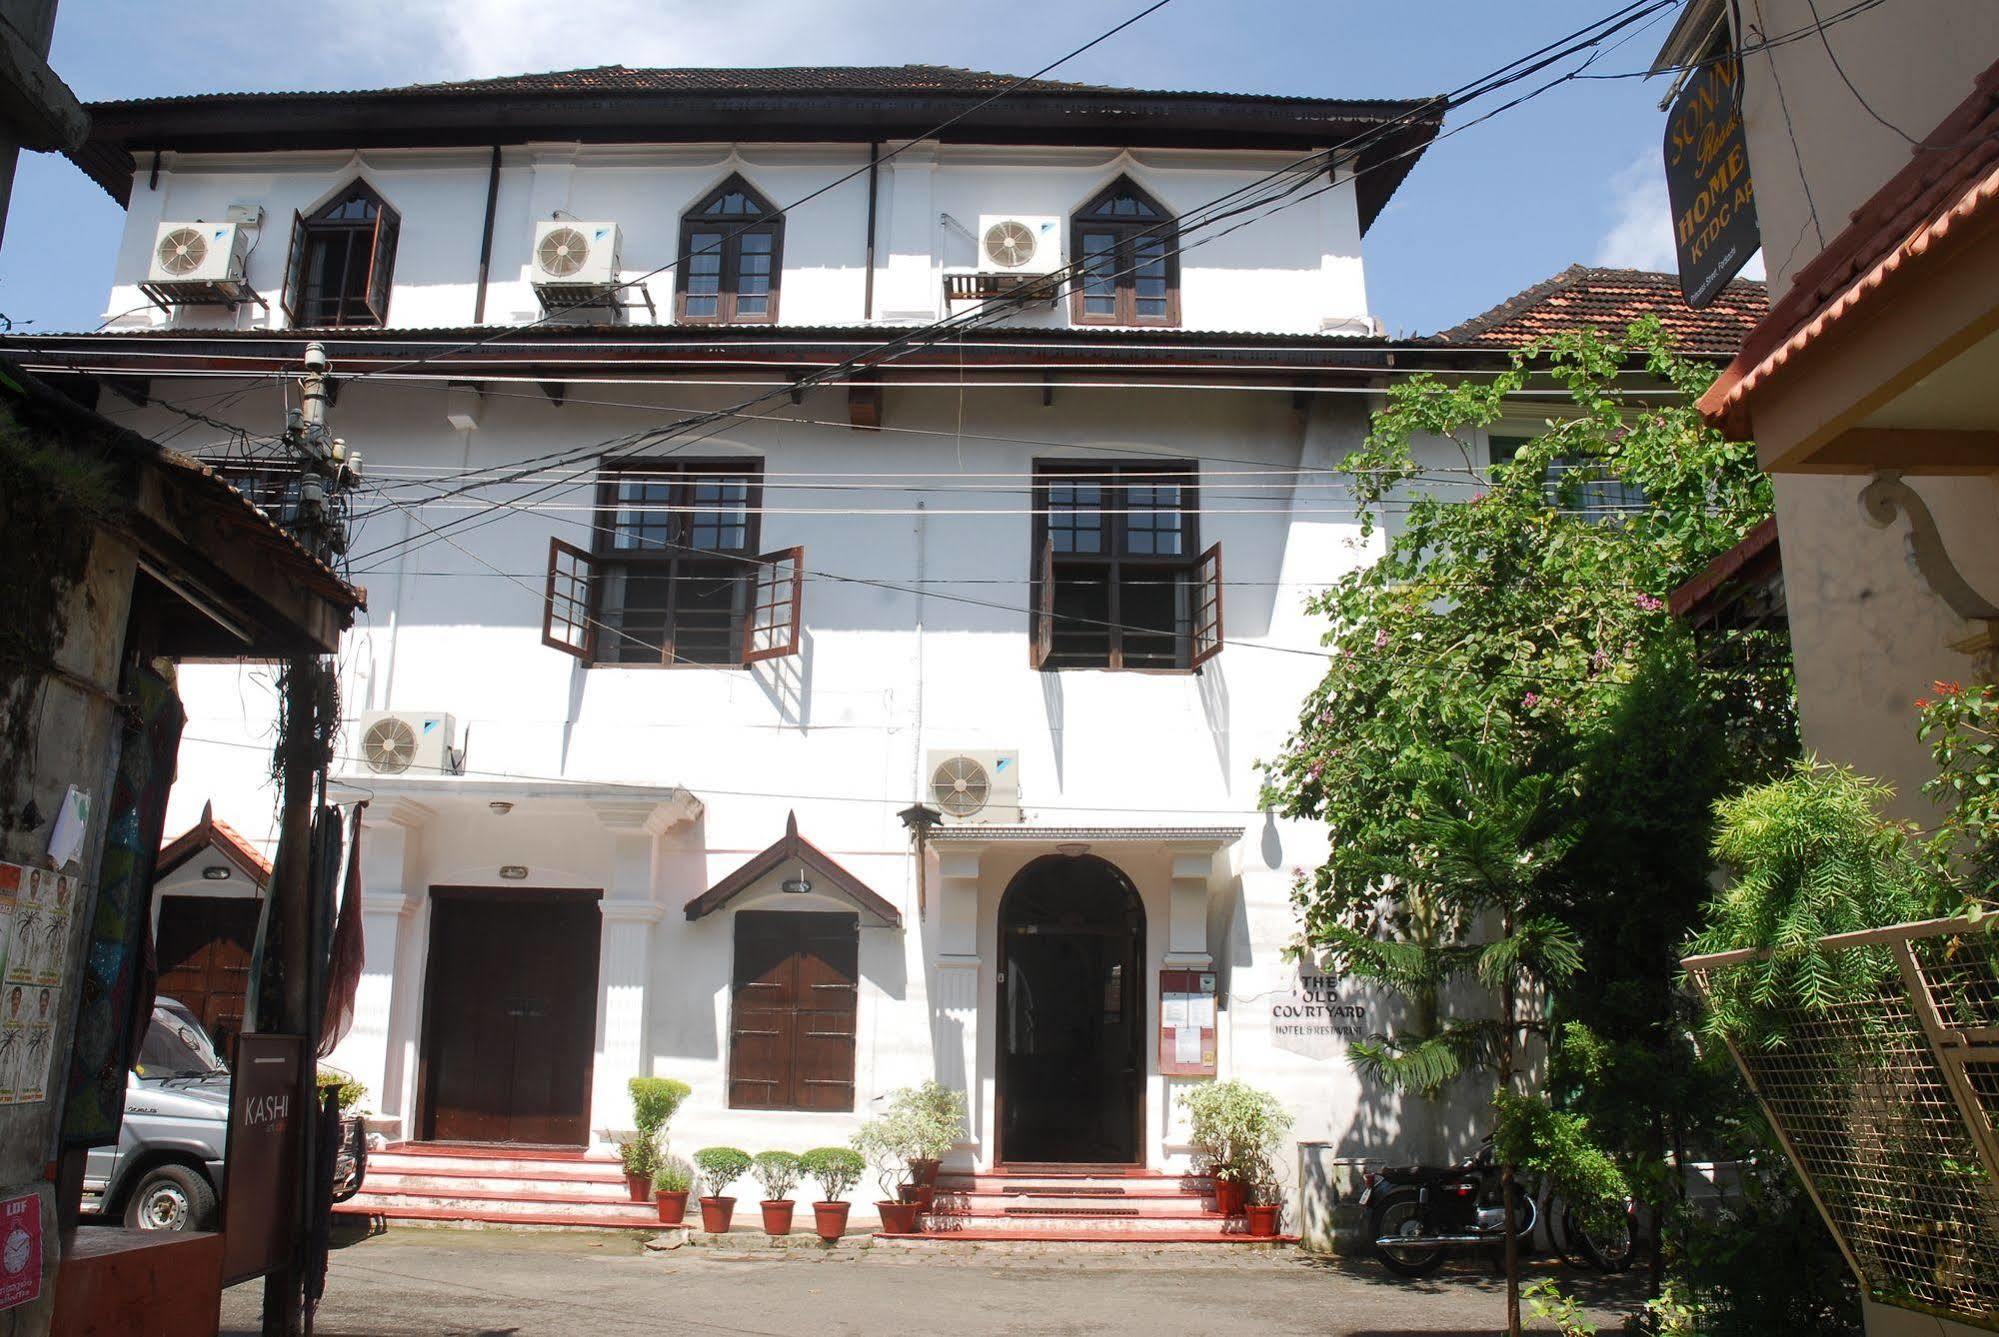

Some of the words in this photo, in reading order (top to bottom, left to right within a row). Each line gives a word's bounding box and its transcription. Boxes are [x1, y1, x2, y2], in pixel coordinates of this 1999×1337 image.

[1678, 143, 1745, 247] HOME
[1691, 203, 1730, 265] KTDC
[1302, 976, 1338, 988] THE
[1302, 991, 1338, 1002] OLD
[1275, 1025, 1304, 1035] HOTEL
[244, 1095, 289, 1126] KASHI
[6, 1200, 27, 1217] LDF
